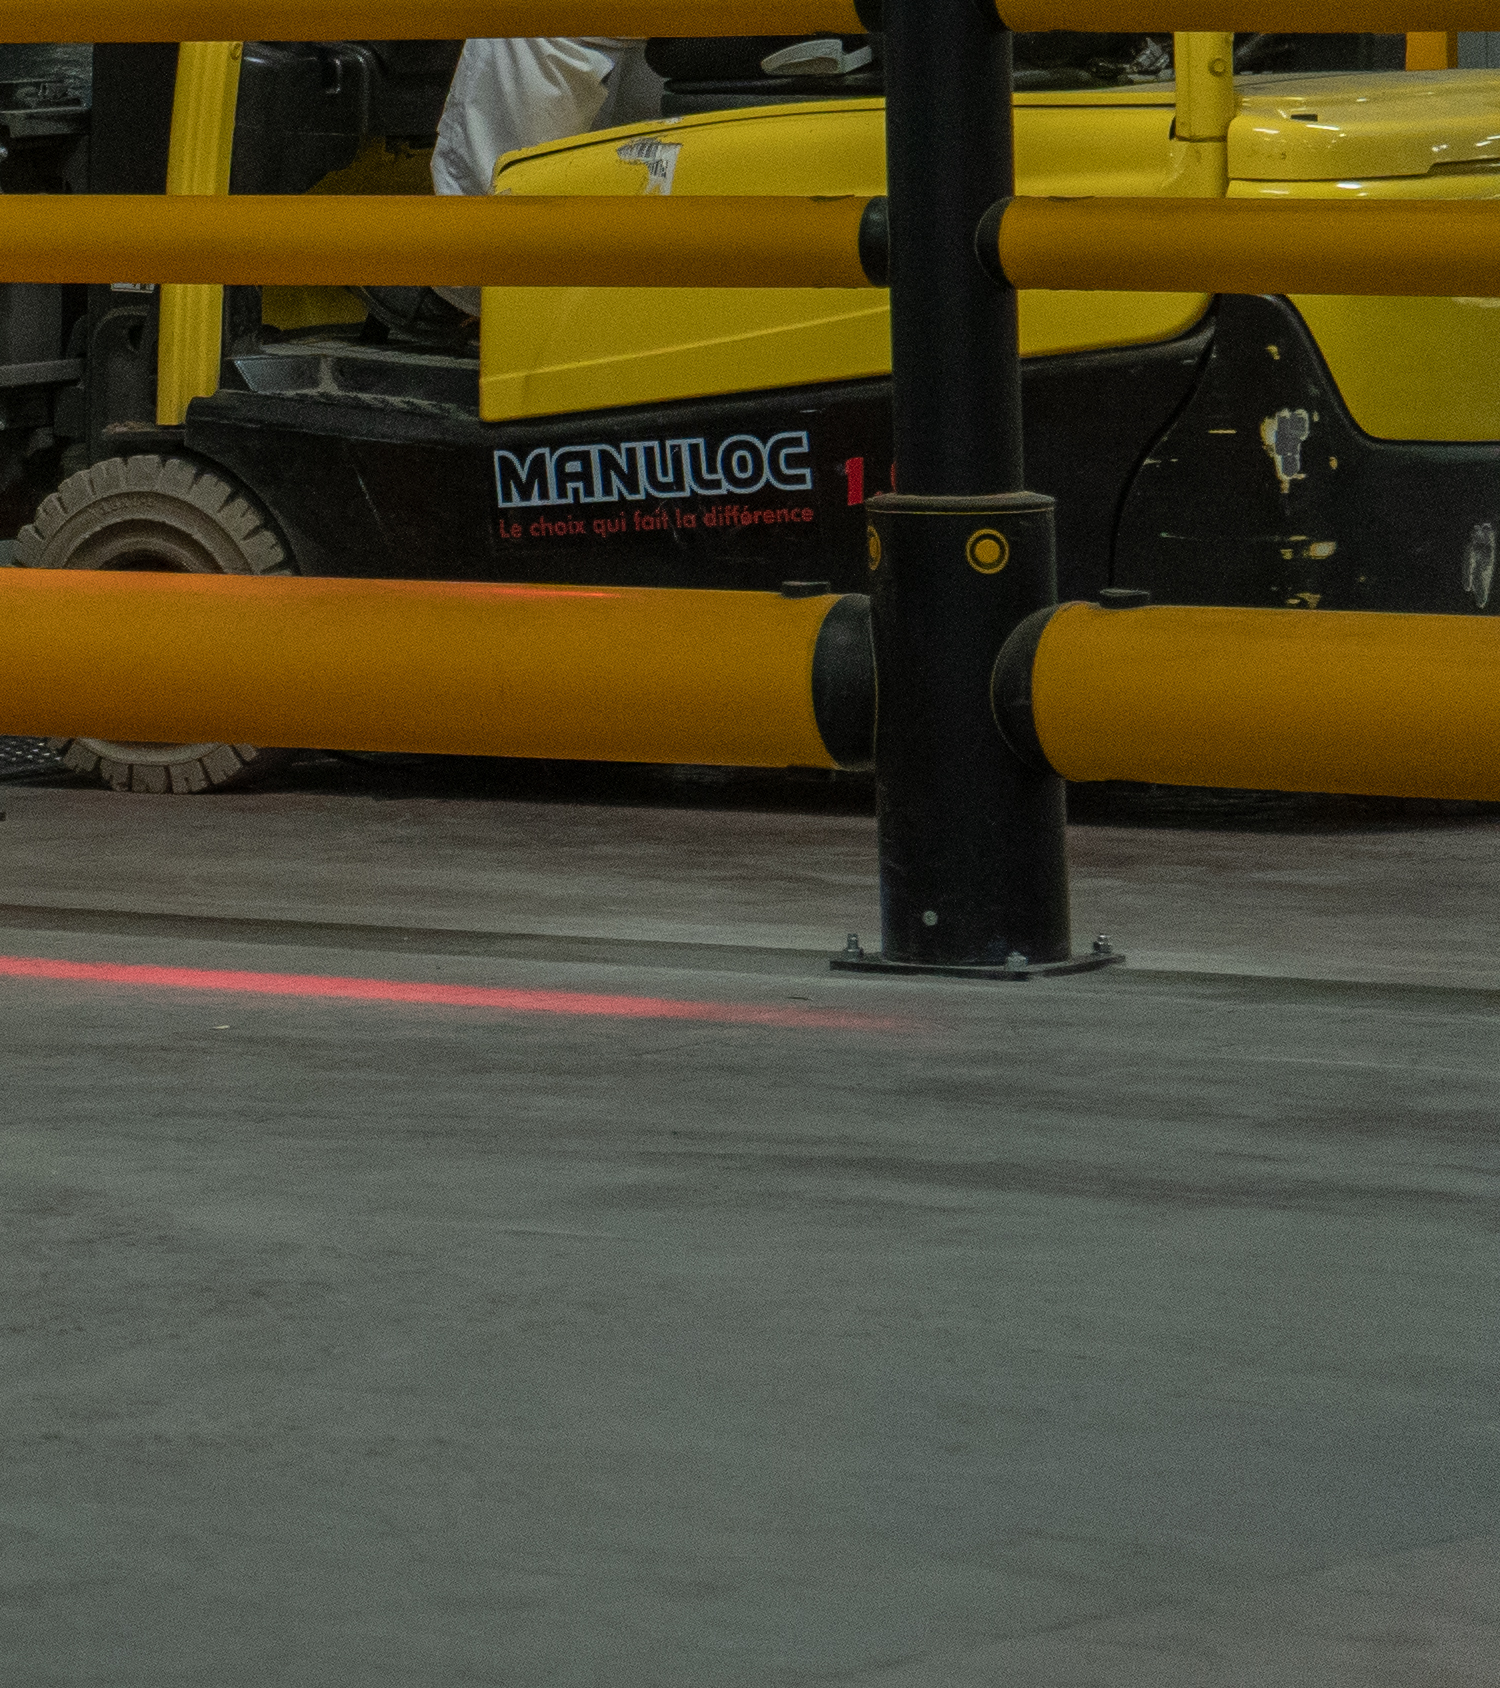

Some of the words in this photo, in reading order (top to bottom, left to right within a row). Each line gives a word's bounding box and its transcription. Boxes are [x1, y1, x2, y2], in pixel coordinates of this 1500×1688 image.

[494, 431, 814, 508] MANULOC
[499, 518, 523, 539] Le
[529, 512, 586, 538] choix
[592, 511, 628, 543] qui
[633, 508, 670, 531] fait
[676, 508, 698, 530] la
[702, 505, 815, 529] différence
